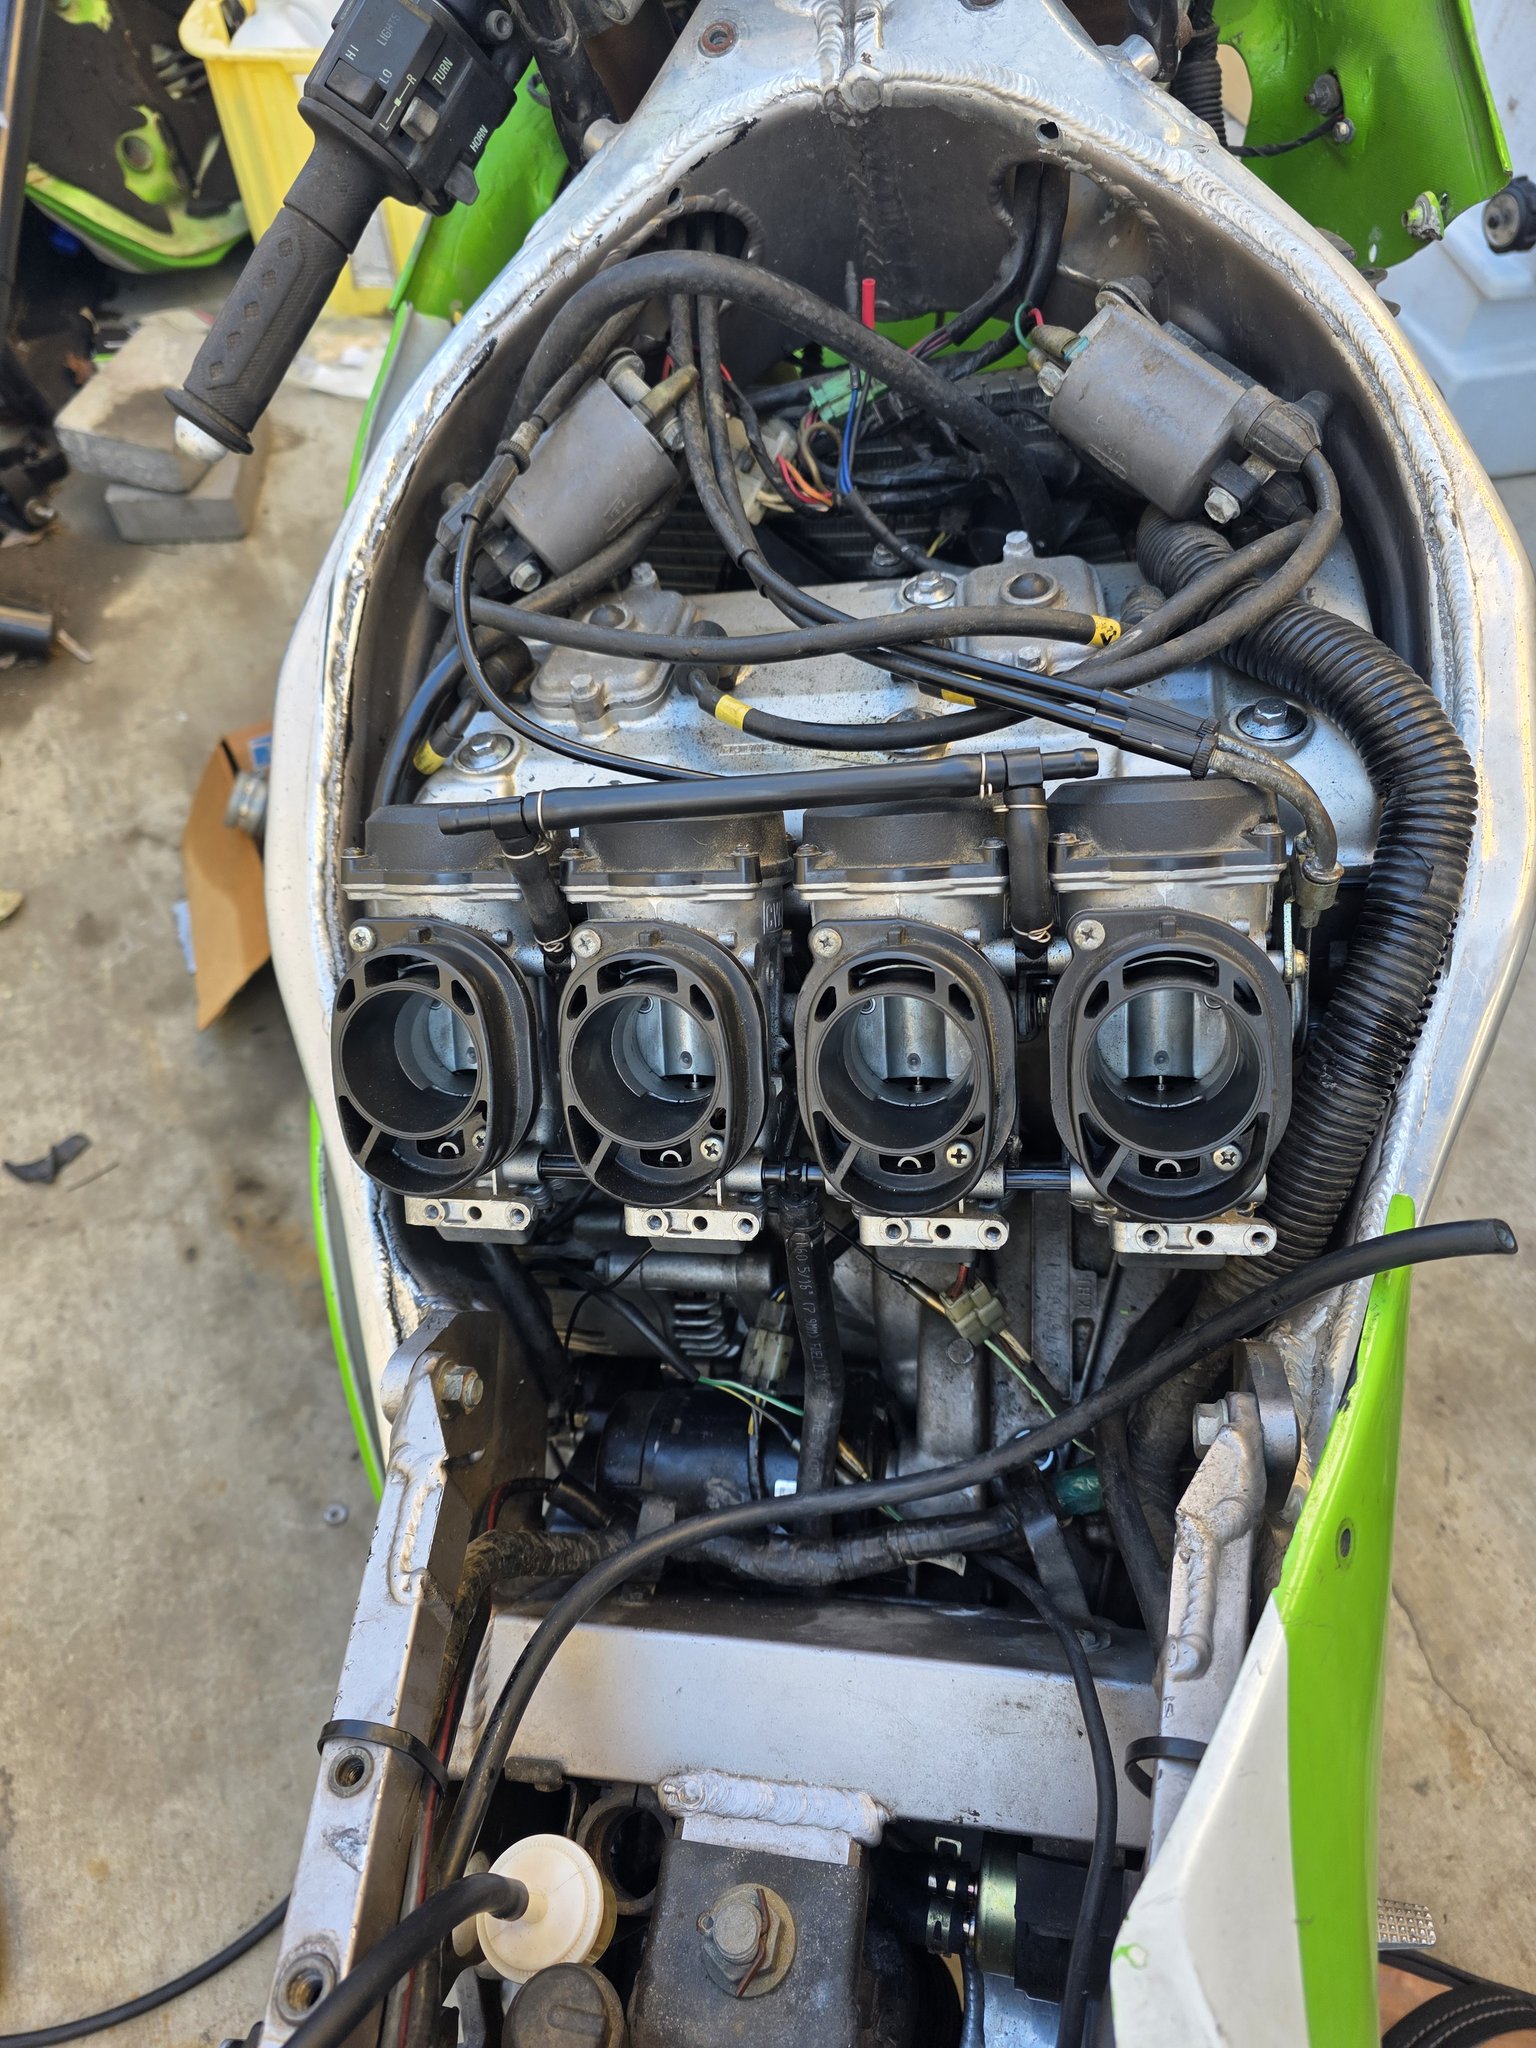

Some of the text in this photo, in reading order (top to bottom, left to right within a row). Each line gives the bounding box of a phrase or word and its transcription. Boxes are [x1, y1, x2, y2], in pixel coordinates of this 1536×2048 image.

[376, 12, 400, 46] LIGHTS
[345, 44, 359, 61] HI
[379, 68, 393, 85] LO
[406, 73, 417, 85] R
[432, 57, 454, 86] TURN
[379, 122, 390, 131] L
[469, 124, 489, 153] HORN
[1077, 1279, 1091, 1310] KHI
